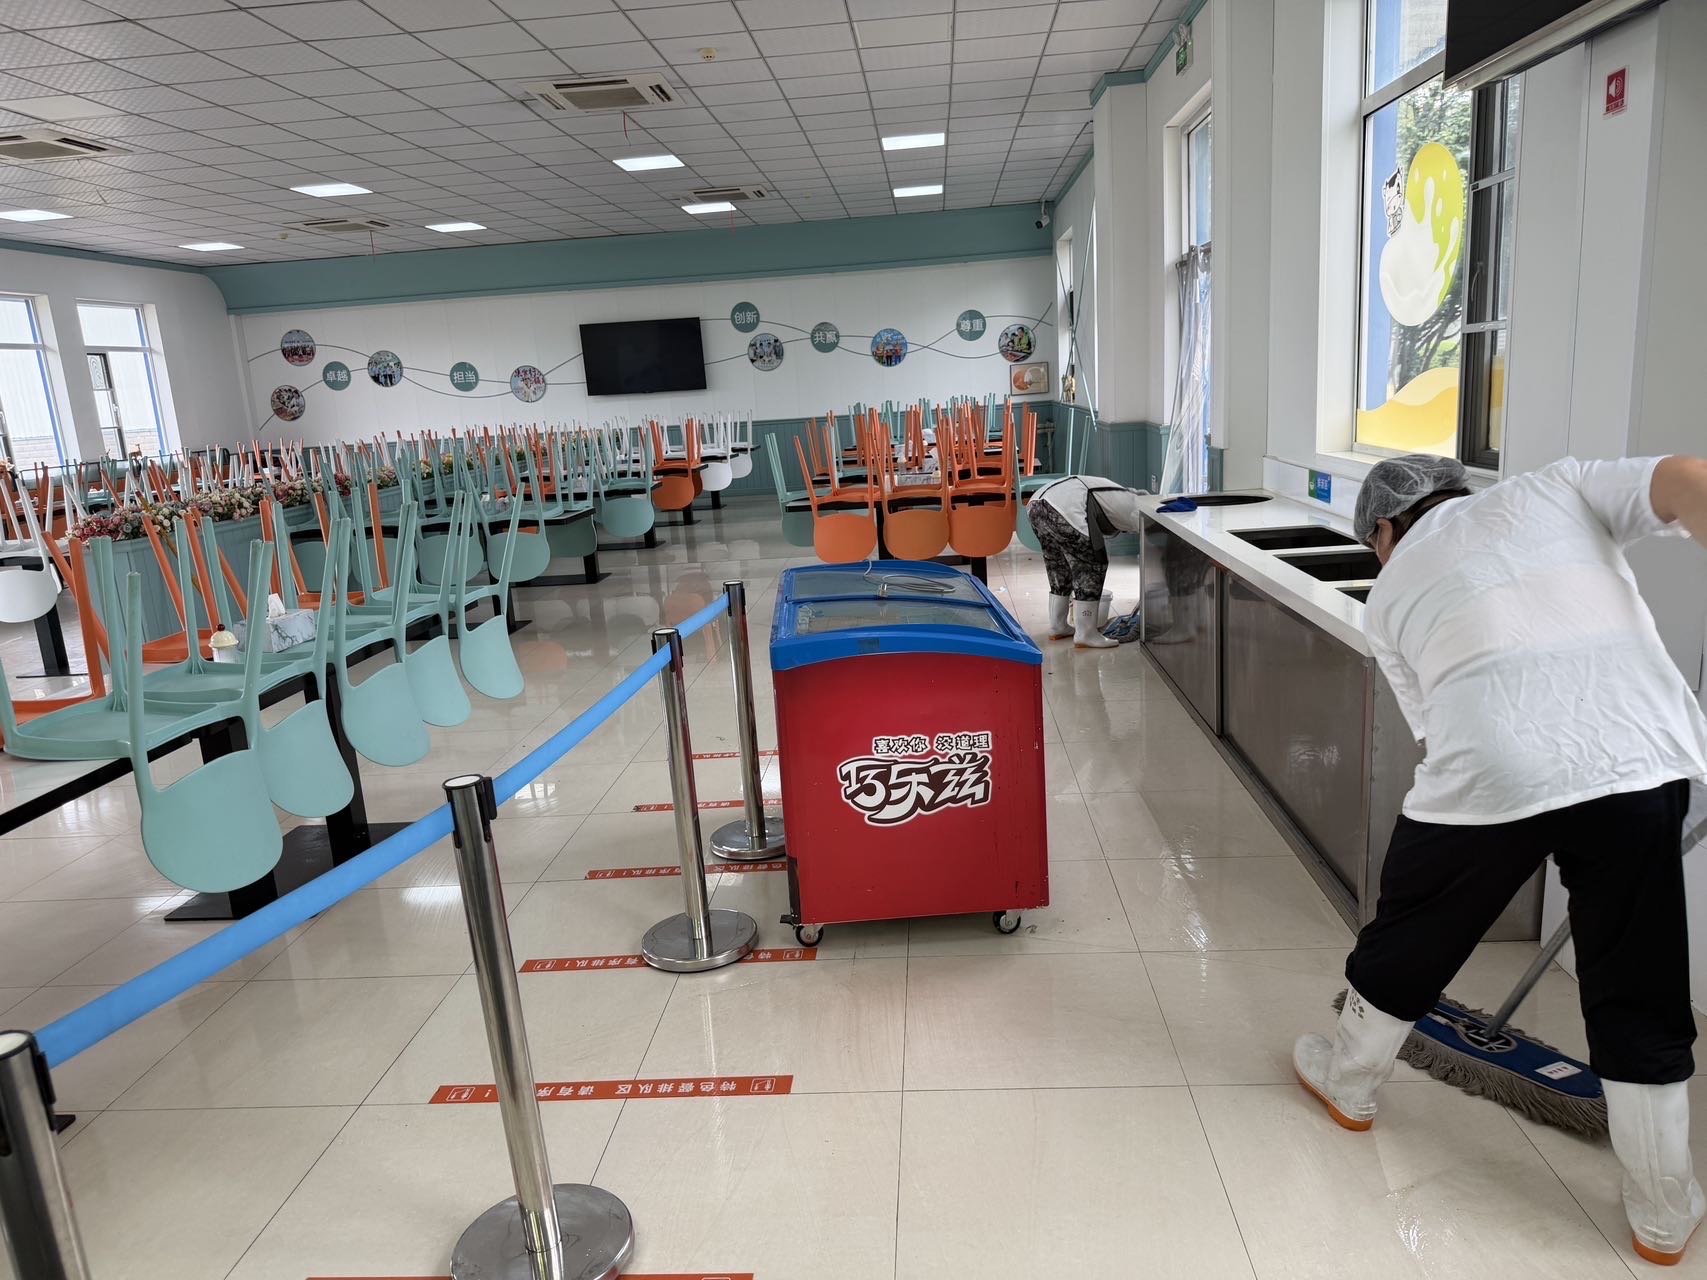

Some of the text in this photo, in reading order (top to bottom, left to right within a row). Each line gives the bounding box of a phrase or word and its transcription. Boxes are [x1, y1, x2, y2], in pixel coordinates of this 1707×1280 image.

[735, 311, 757, 324] 创新
[326, 370, 348, 382] 卓越
[453, 370, 476, 383] 担当
[874, 733, 990, 754] 喜欢你 没道理
[839, 752, 991, 823] 巧乐兹
[613, 1081, 738, 1095] 特色餐排队区
